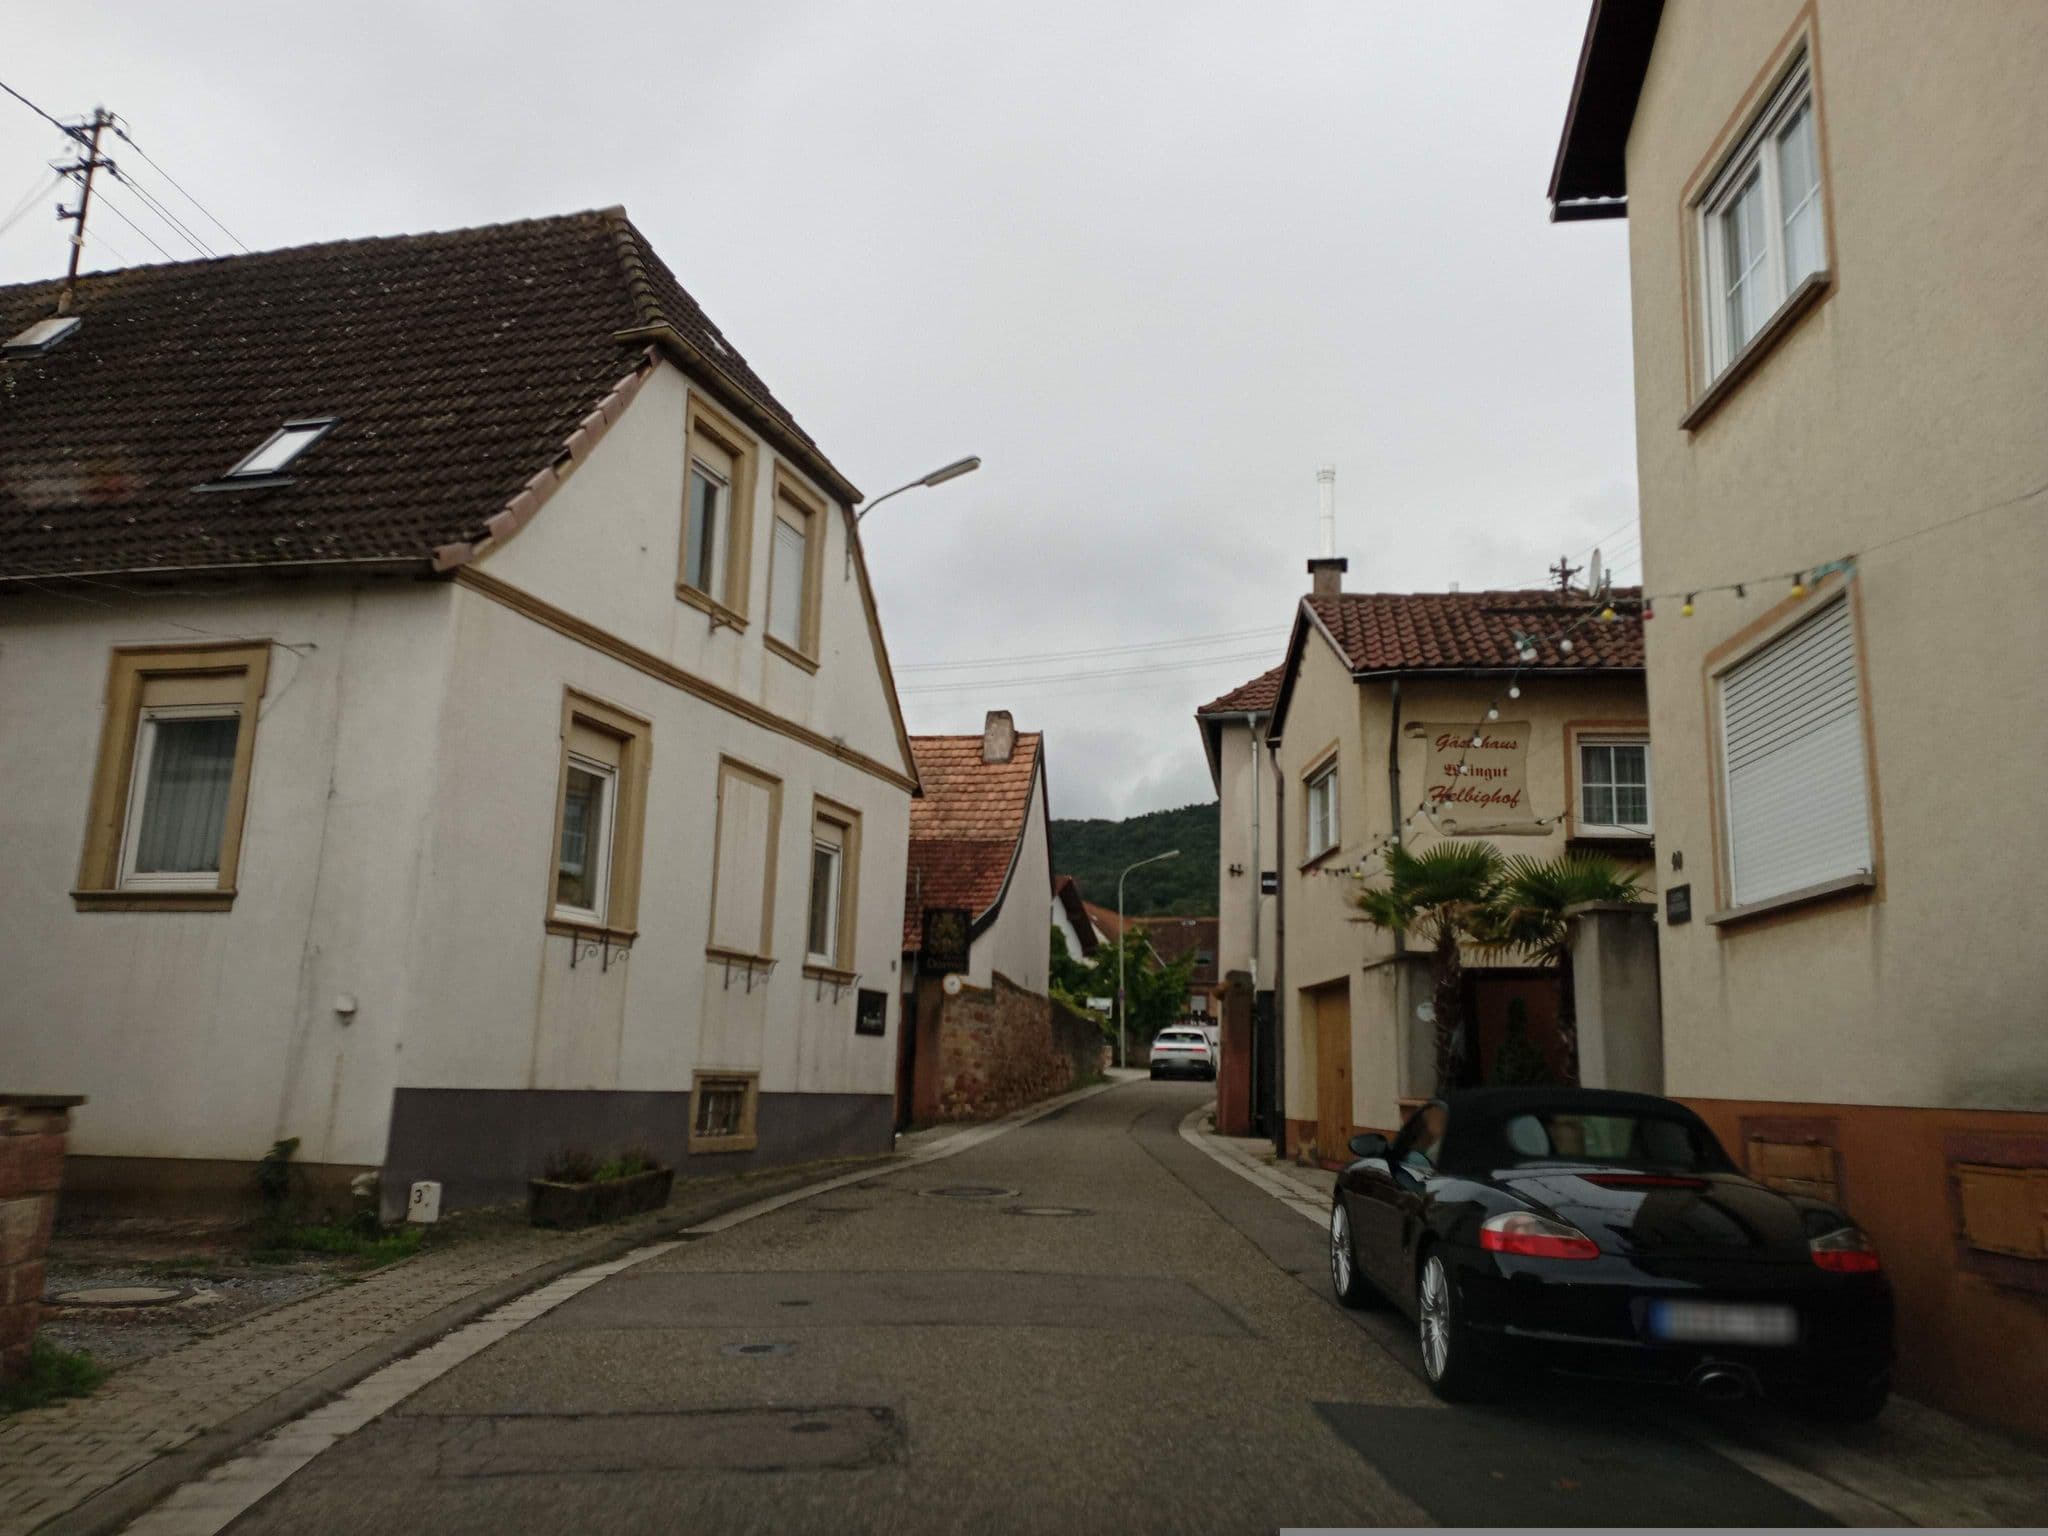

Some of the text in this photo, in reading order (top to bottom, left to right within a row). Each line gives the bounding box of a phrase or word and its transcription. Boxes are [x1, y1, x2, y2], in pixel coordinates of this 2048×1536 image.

[1435, 734, 1518, 752] Gästhaus
[1429, 785, 1520, 808] Helbighof
[413, 1189, 423, 1204] 3
